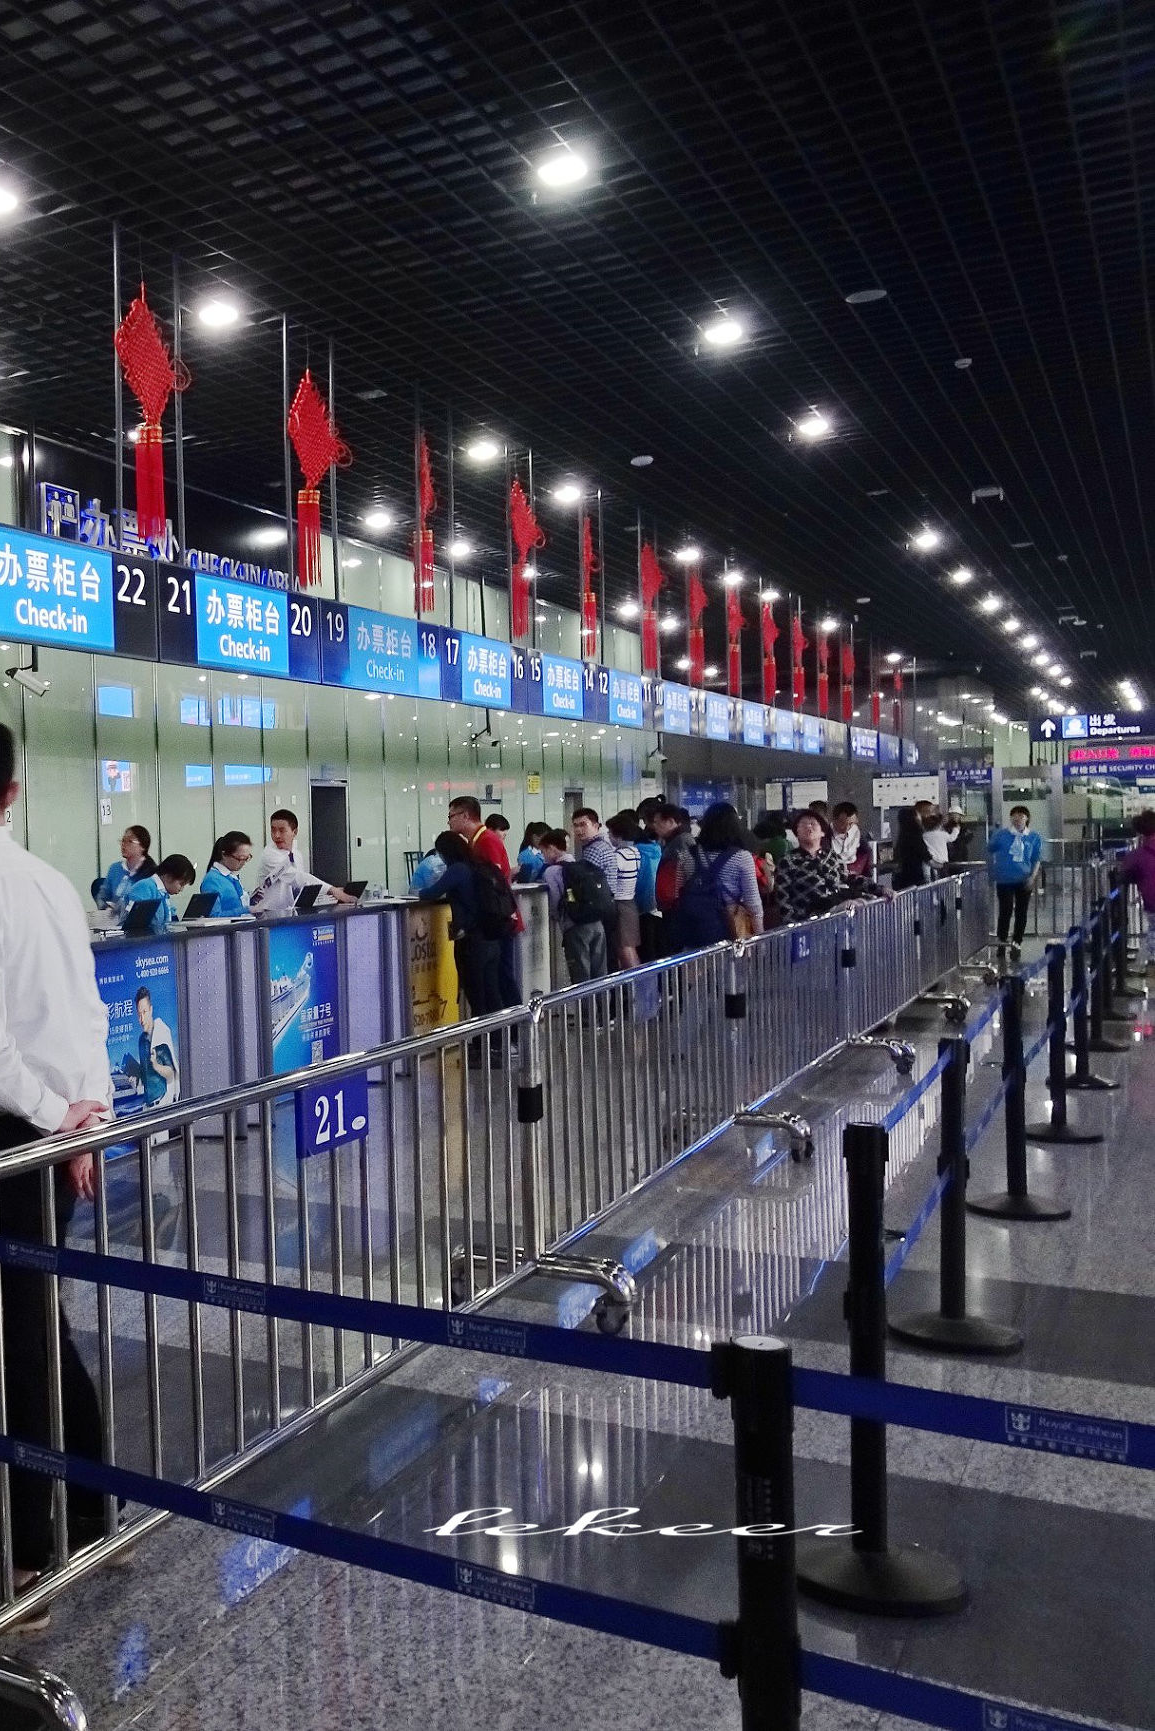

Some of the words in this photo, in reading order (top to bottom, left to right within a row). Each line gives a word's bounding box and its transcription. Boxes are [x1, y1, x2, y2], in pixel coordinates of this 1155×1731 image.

[116, 564, 147, 606] 22
[167, 577, 192, 616] 21
[15, 598, 88, 635] Check-in
[206, 588, 280, 636] 办票柜台
[290, 602, 312, 638] 20
[326, 611, 344, 642] 19
[219, 634, 271, 663] Check-in
[357, 621, 412, 660] 办票柜台
[421, 632, 437, 659] 18
[446, 637, 459, 666] 17
[366, 658, 405, 682] Check-in
[467, 645, 507, 679] 办票柜台
[513, 654, 524, 679] 16
[530, 657, 541, 682] 15
[547, 662, 579, 692] 办票柜台
[584, 668, 594, 692] 14
[599, 671, 608, 694] 12
[473, 681, 502, 700] Check-in
[552, 692, 576, 710] Check-in
[644, 683, 651, 703] 11
[655, 685, 663, 706] 10
[1089, 714, 1117, 727] 出发
[1090, 726, 1141, 737] Departures
[1109, 763, 1143, 772] SECURITY
[5, 810, 13, 824] 2
[100, 803, 112, 817] 13
[135, 955, 169, 969] skysea.com
